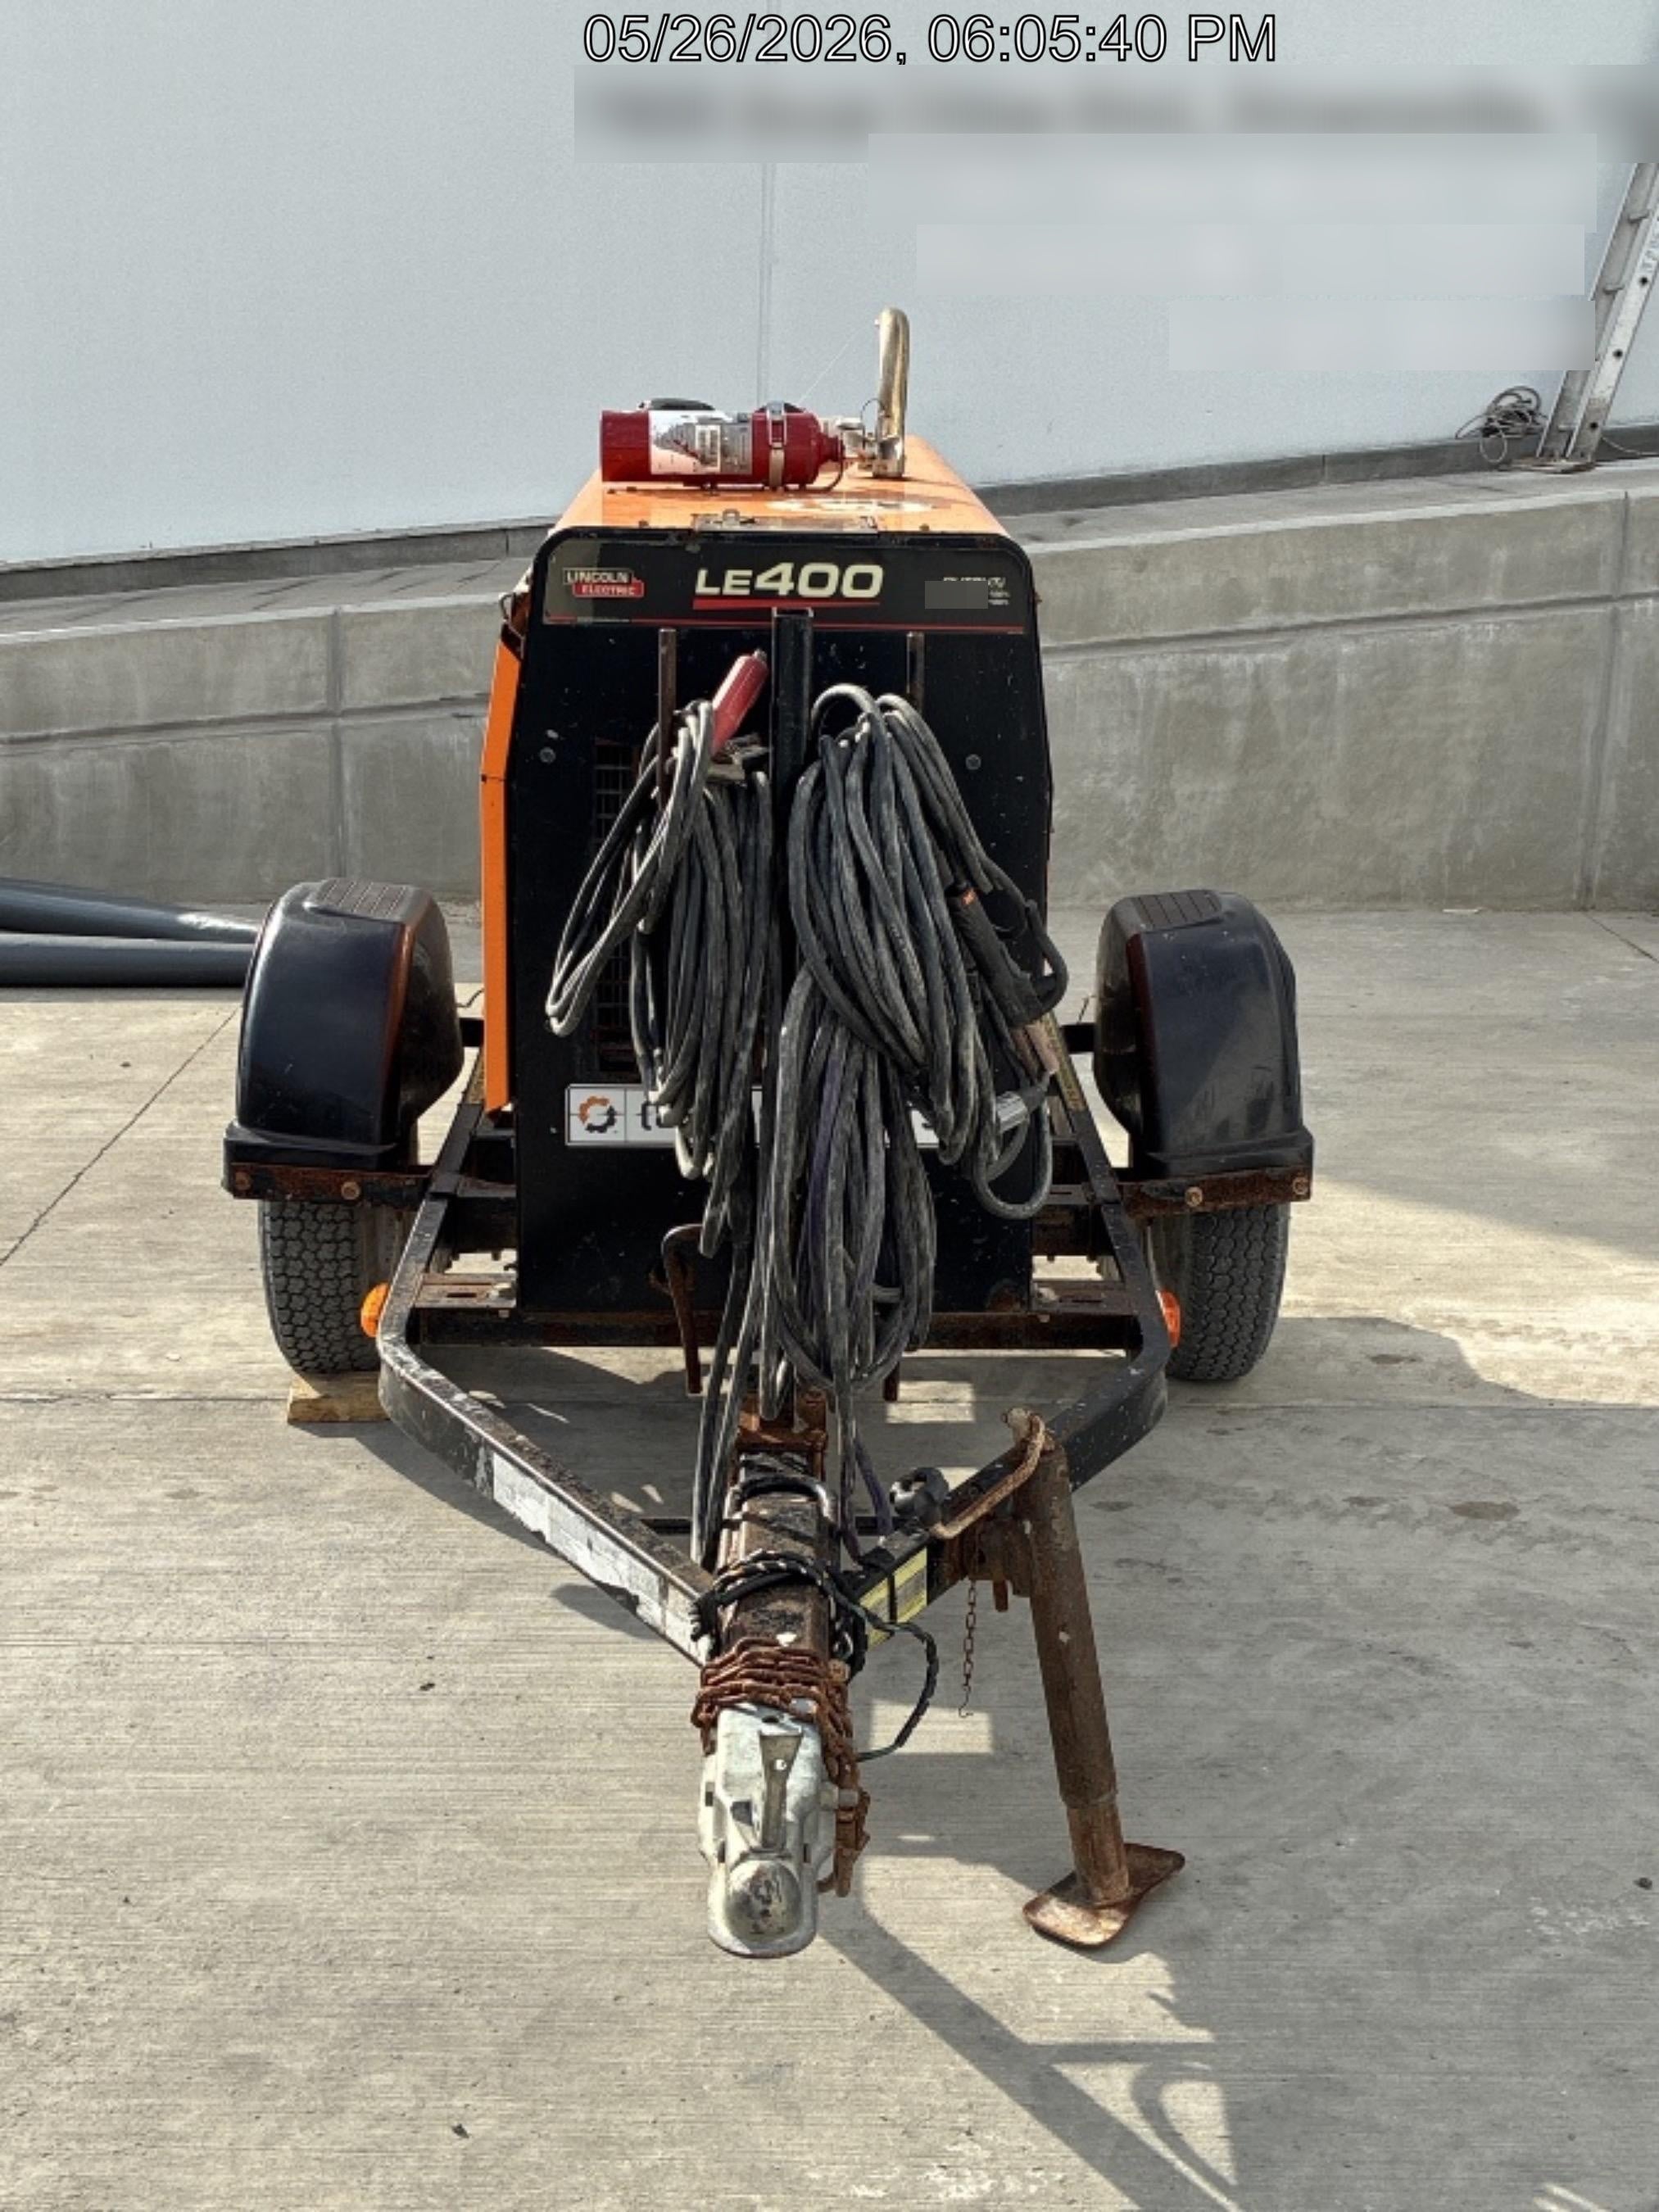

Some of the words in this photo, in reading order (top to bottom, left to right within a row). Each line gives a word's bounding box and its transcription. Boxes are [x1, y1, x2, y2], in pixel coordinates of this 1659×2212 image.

[566, 570, 628, 583] LINCOLN
[695, 562, 884, 598] LE400
[581, 583, 636, 596] ELECTRIC
